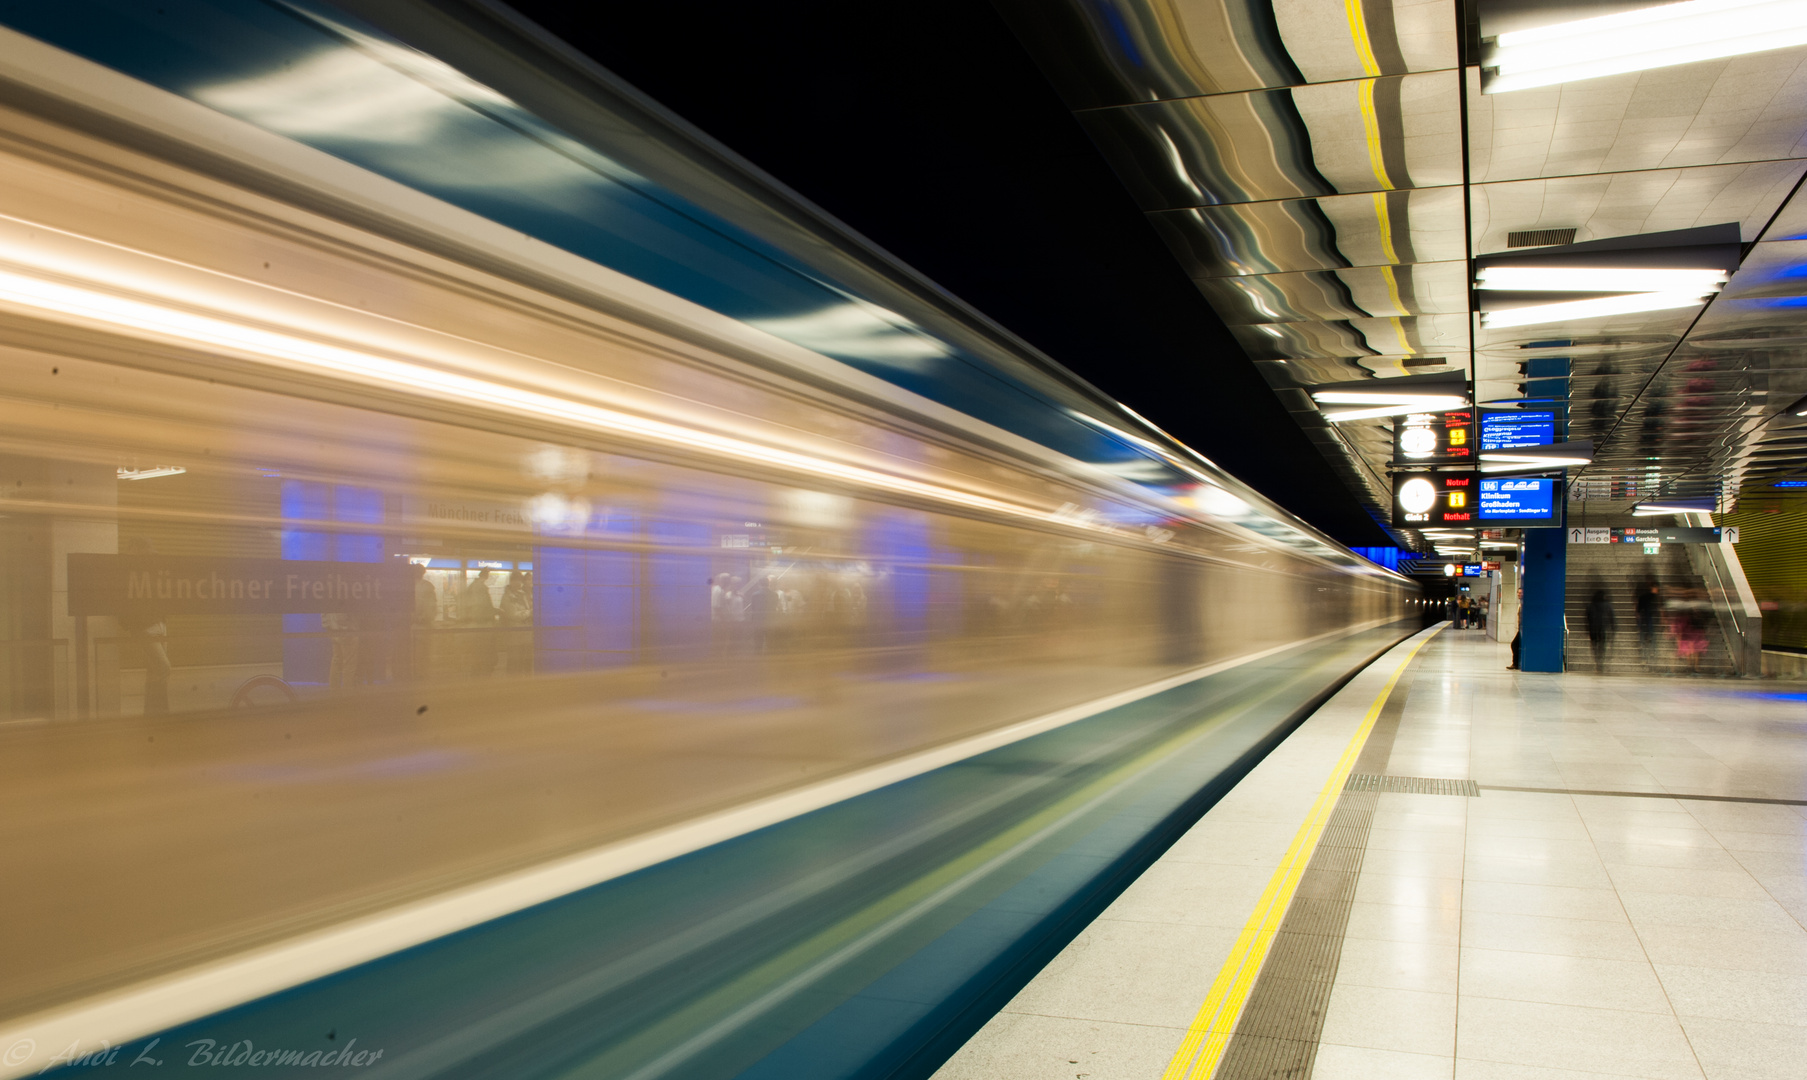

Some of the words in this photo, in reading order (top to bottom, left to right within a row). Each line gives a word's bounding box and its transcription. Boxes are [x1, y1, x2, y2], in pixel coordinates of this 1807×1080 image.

[1446, 478, 1469, 487] Notruf
[1481, 492, 1511, 500] Klinikum
[428, 503, 490, 522] Münchner
[1444, 512, 1471, 521] Nothalt
[1405, 513, 1422, 522] Gleis
[1423, 513, 1430, 521] 2
[127, 571, 274, 600] Münchner
[286, 574, 382, 600] Freiheit
